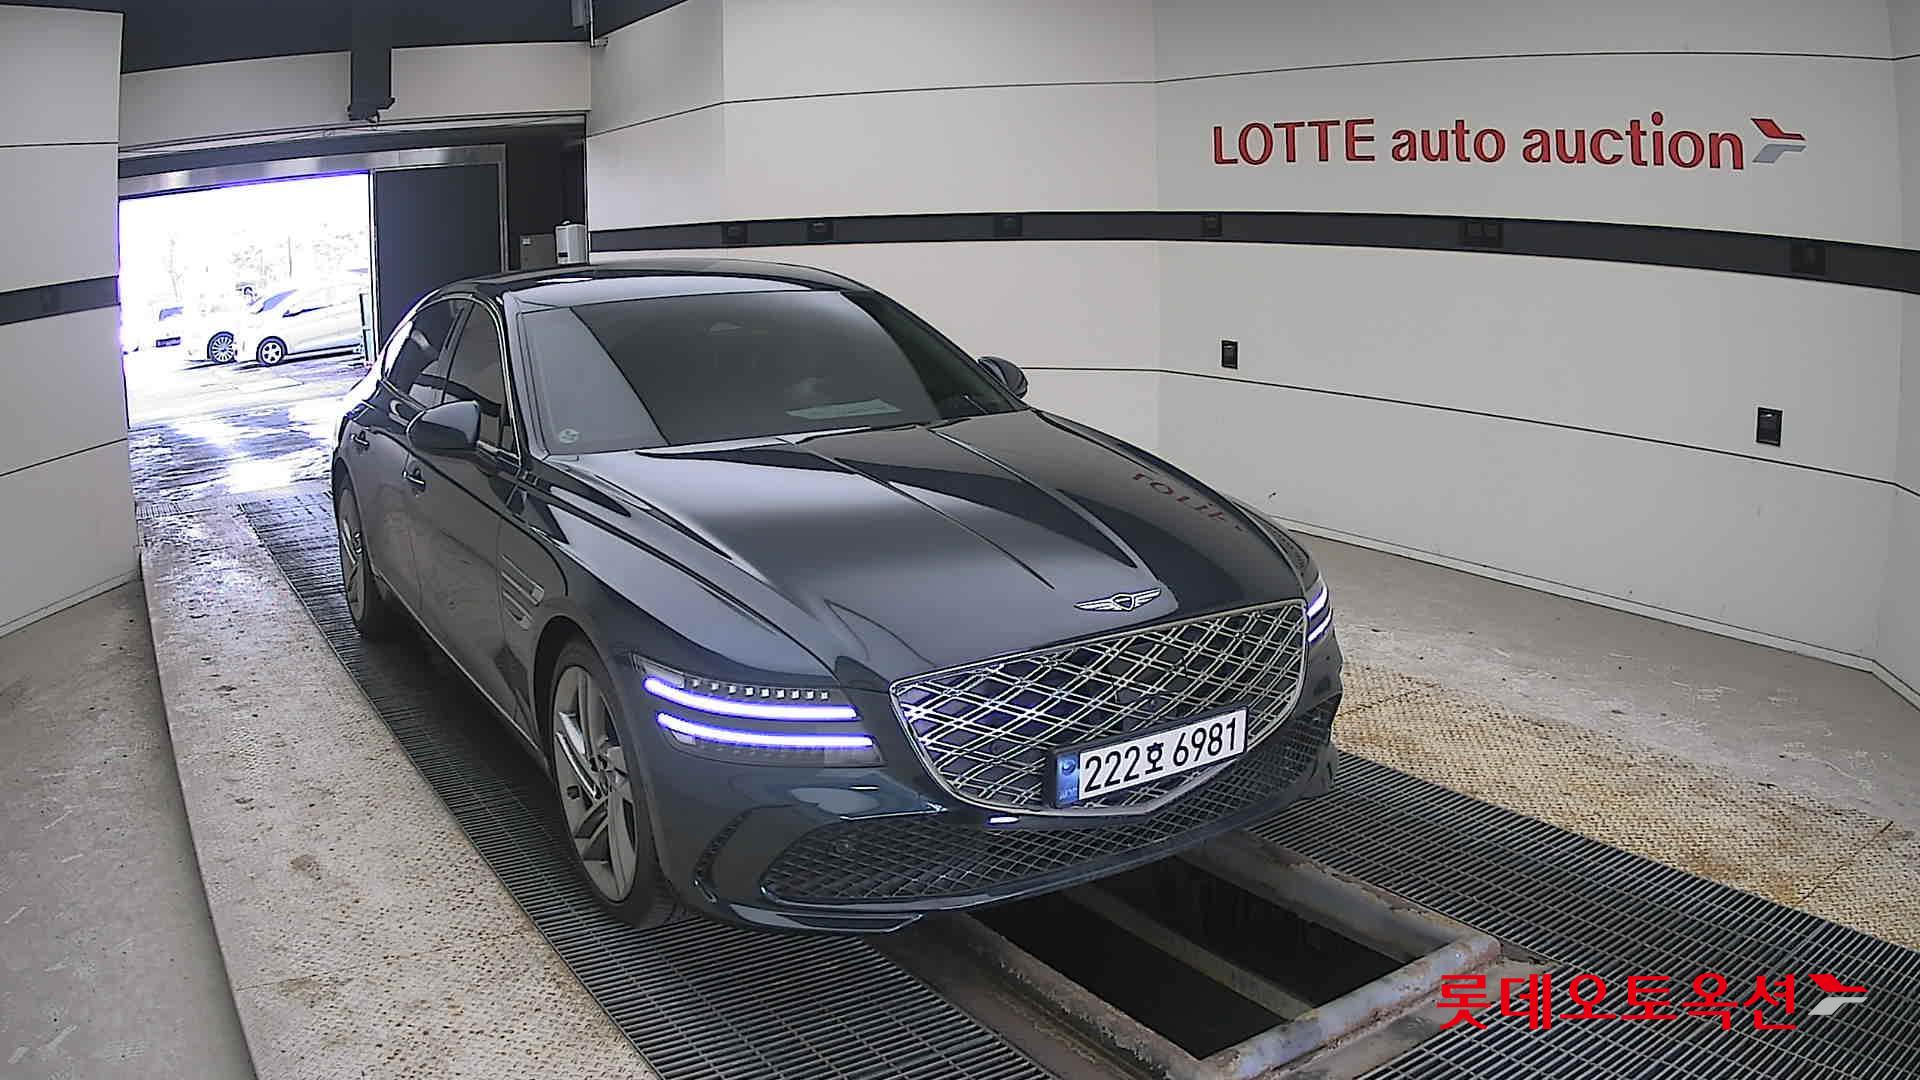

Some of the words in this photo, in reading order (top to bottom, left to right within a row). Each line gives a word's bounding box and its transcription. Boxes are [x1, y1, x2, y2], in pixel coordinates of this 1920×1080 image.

[1212, 118, 1376, 166] LOTTE
[1391, 119, 1507, 163] auto
[1521, 111, 1745, 171] auction
[1083, 742, 1165, 794] 222호
[1172, 717, 1237, 768] 6981
